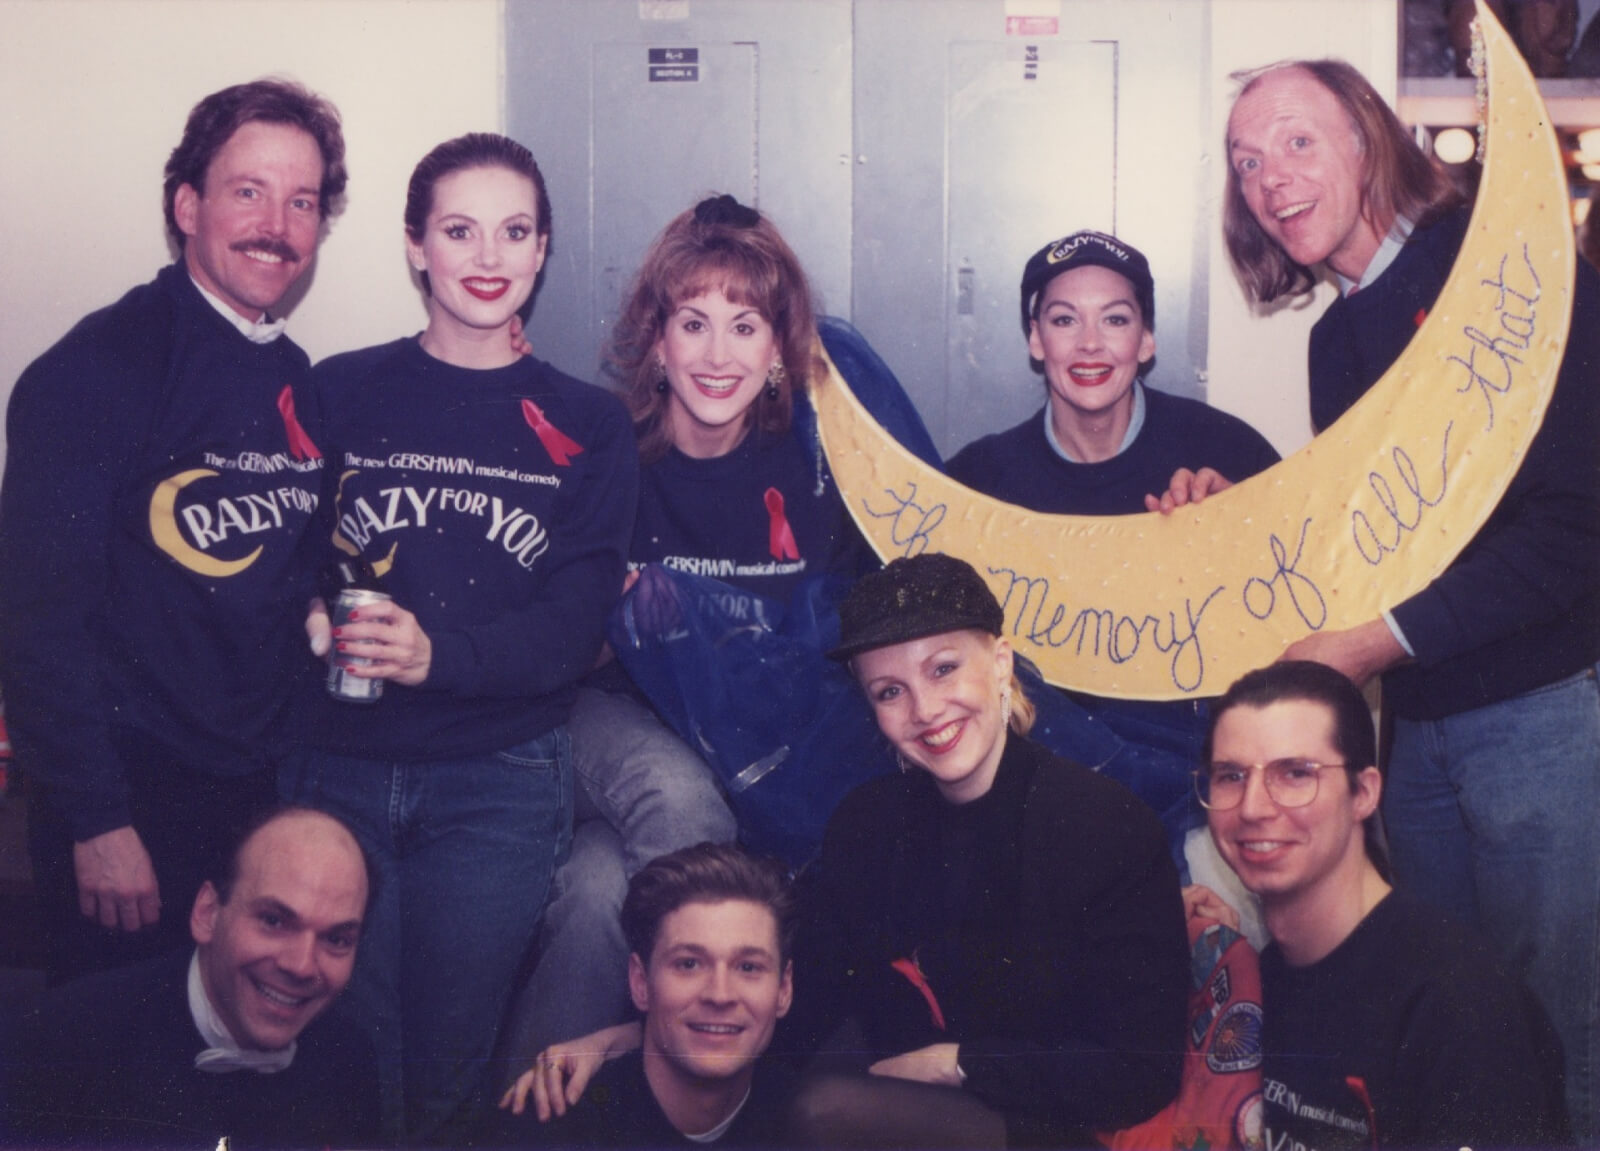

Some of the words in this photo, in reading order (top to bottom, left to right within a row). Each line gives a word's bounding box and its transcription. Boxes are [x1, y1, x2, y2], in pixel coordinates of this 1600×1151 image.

[861, 481, 947, 559] th
[1243, 517, 1327, 631] of
[1351, 419, 1454, 566] all
[1446, 242, 1542, 432] that
[363, 458, 386, 468] new
[388, 453, 474, 475] GERSHWIN
[475, 466, 518, 480] musical
[518, 474, 561, 488] comedy
[277, 487, 312, 514] FOR
[439, 488, 489, 516] FOR
[485, 496, 549, 568] YOU
[736, 560, 776, 576] musical
